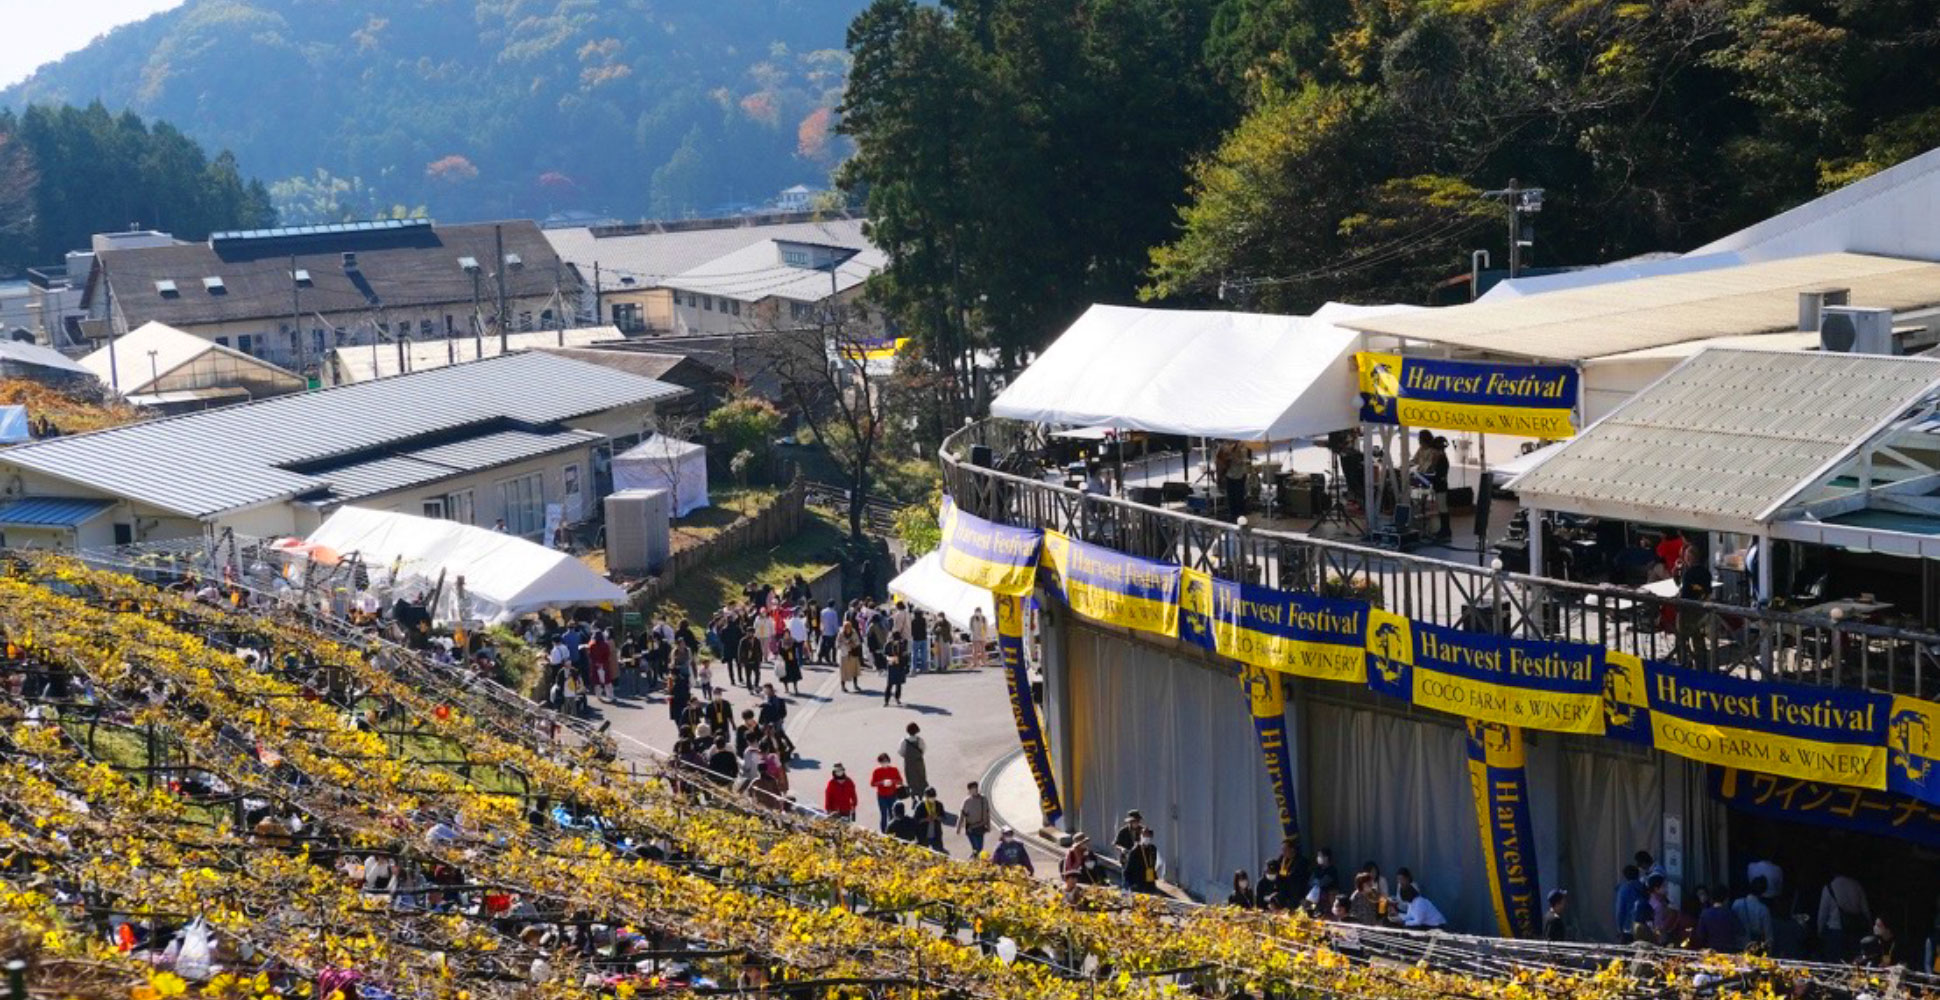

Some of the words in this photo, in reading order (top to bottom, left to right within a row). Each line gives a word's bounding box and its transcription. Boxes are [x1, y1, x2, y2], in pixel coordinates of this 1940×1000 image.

[1406, 366, 1482, 394] Harvest
[1486, 373, 1567, 398] Festival
[1403, 407, 1442, 424] COCO
[1446, 411, 1479, 428] FARM
[1486, 416, 1494, 429] &
[1498, 414, 1561, 432] WINERY
[1219, 585, 1282, 625] Harvest
[1287, 602, 1359, 635] Festival
[1287, 654, 1296, 665] &
[1300, 650, 1359, 672] WINERY
[1420, 631, 1502, 672] Harvest
[1510, 647, 1593, 681] Festival
[1422, 679, 1465, 703] COCO
[1469, 690, 1506, 712] FARM
[1514, 703, 1524, 716] &
[1529, 699, 1592, 721] WINERY
[1655, 673, 1761, 719] Harvest
[1770, 693, 1875, 732] Festival
[1662, 723, 1712, 751] COCO
[1719, 737, 1770, 761] FARM
[1779, 749, 1792, 764] &
[1797, 747, 1873, 775] WINERY
[1496, 781, 1529, 885] Harvest
